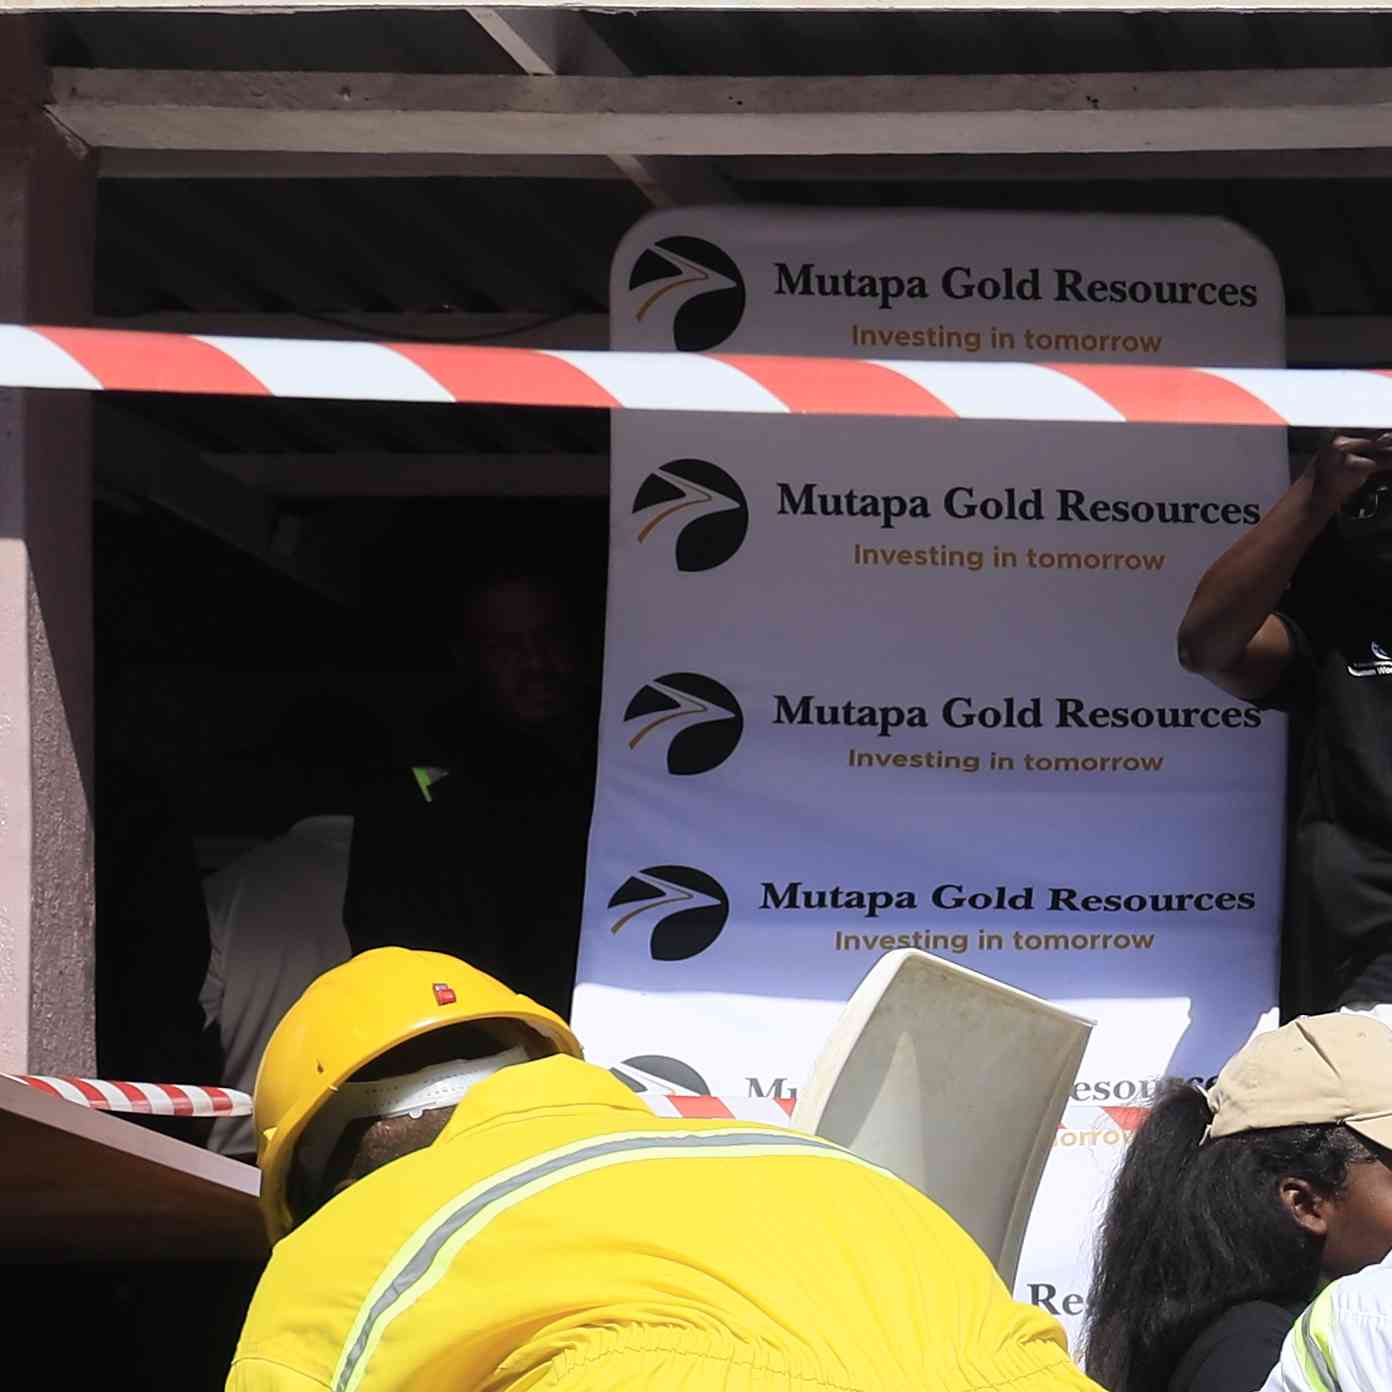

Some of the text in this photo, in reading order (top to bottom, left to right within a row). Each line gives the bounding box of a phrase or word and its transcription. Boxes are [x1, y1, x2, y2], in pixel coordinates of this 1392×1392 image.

[774, 263, 1257, 309] Mutapa Gold Resources
[852, 324, 1162, 352] Investing in tomorrow
[777, 483, 1260, 528] Mutapa Gold Resources
[851, 544, 1165, 571] Investing in tomorrow
[773, 696, 1263, 737] Mutapa Gold Resources
[849, 749, 1163, 772] Investing in tomorrow
[760, 882, 1256, 917] Mutapa Gold Resources
[833, 929, 1154, 954] Investing in tomorrow
